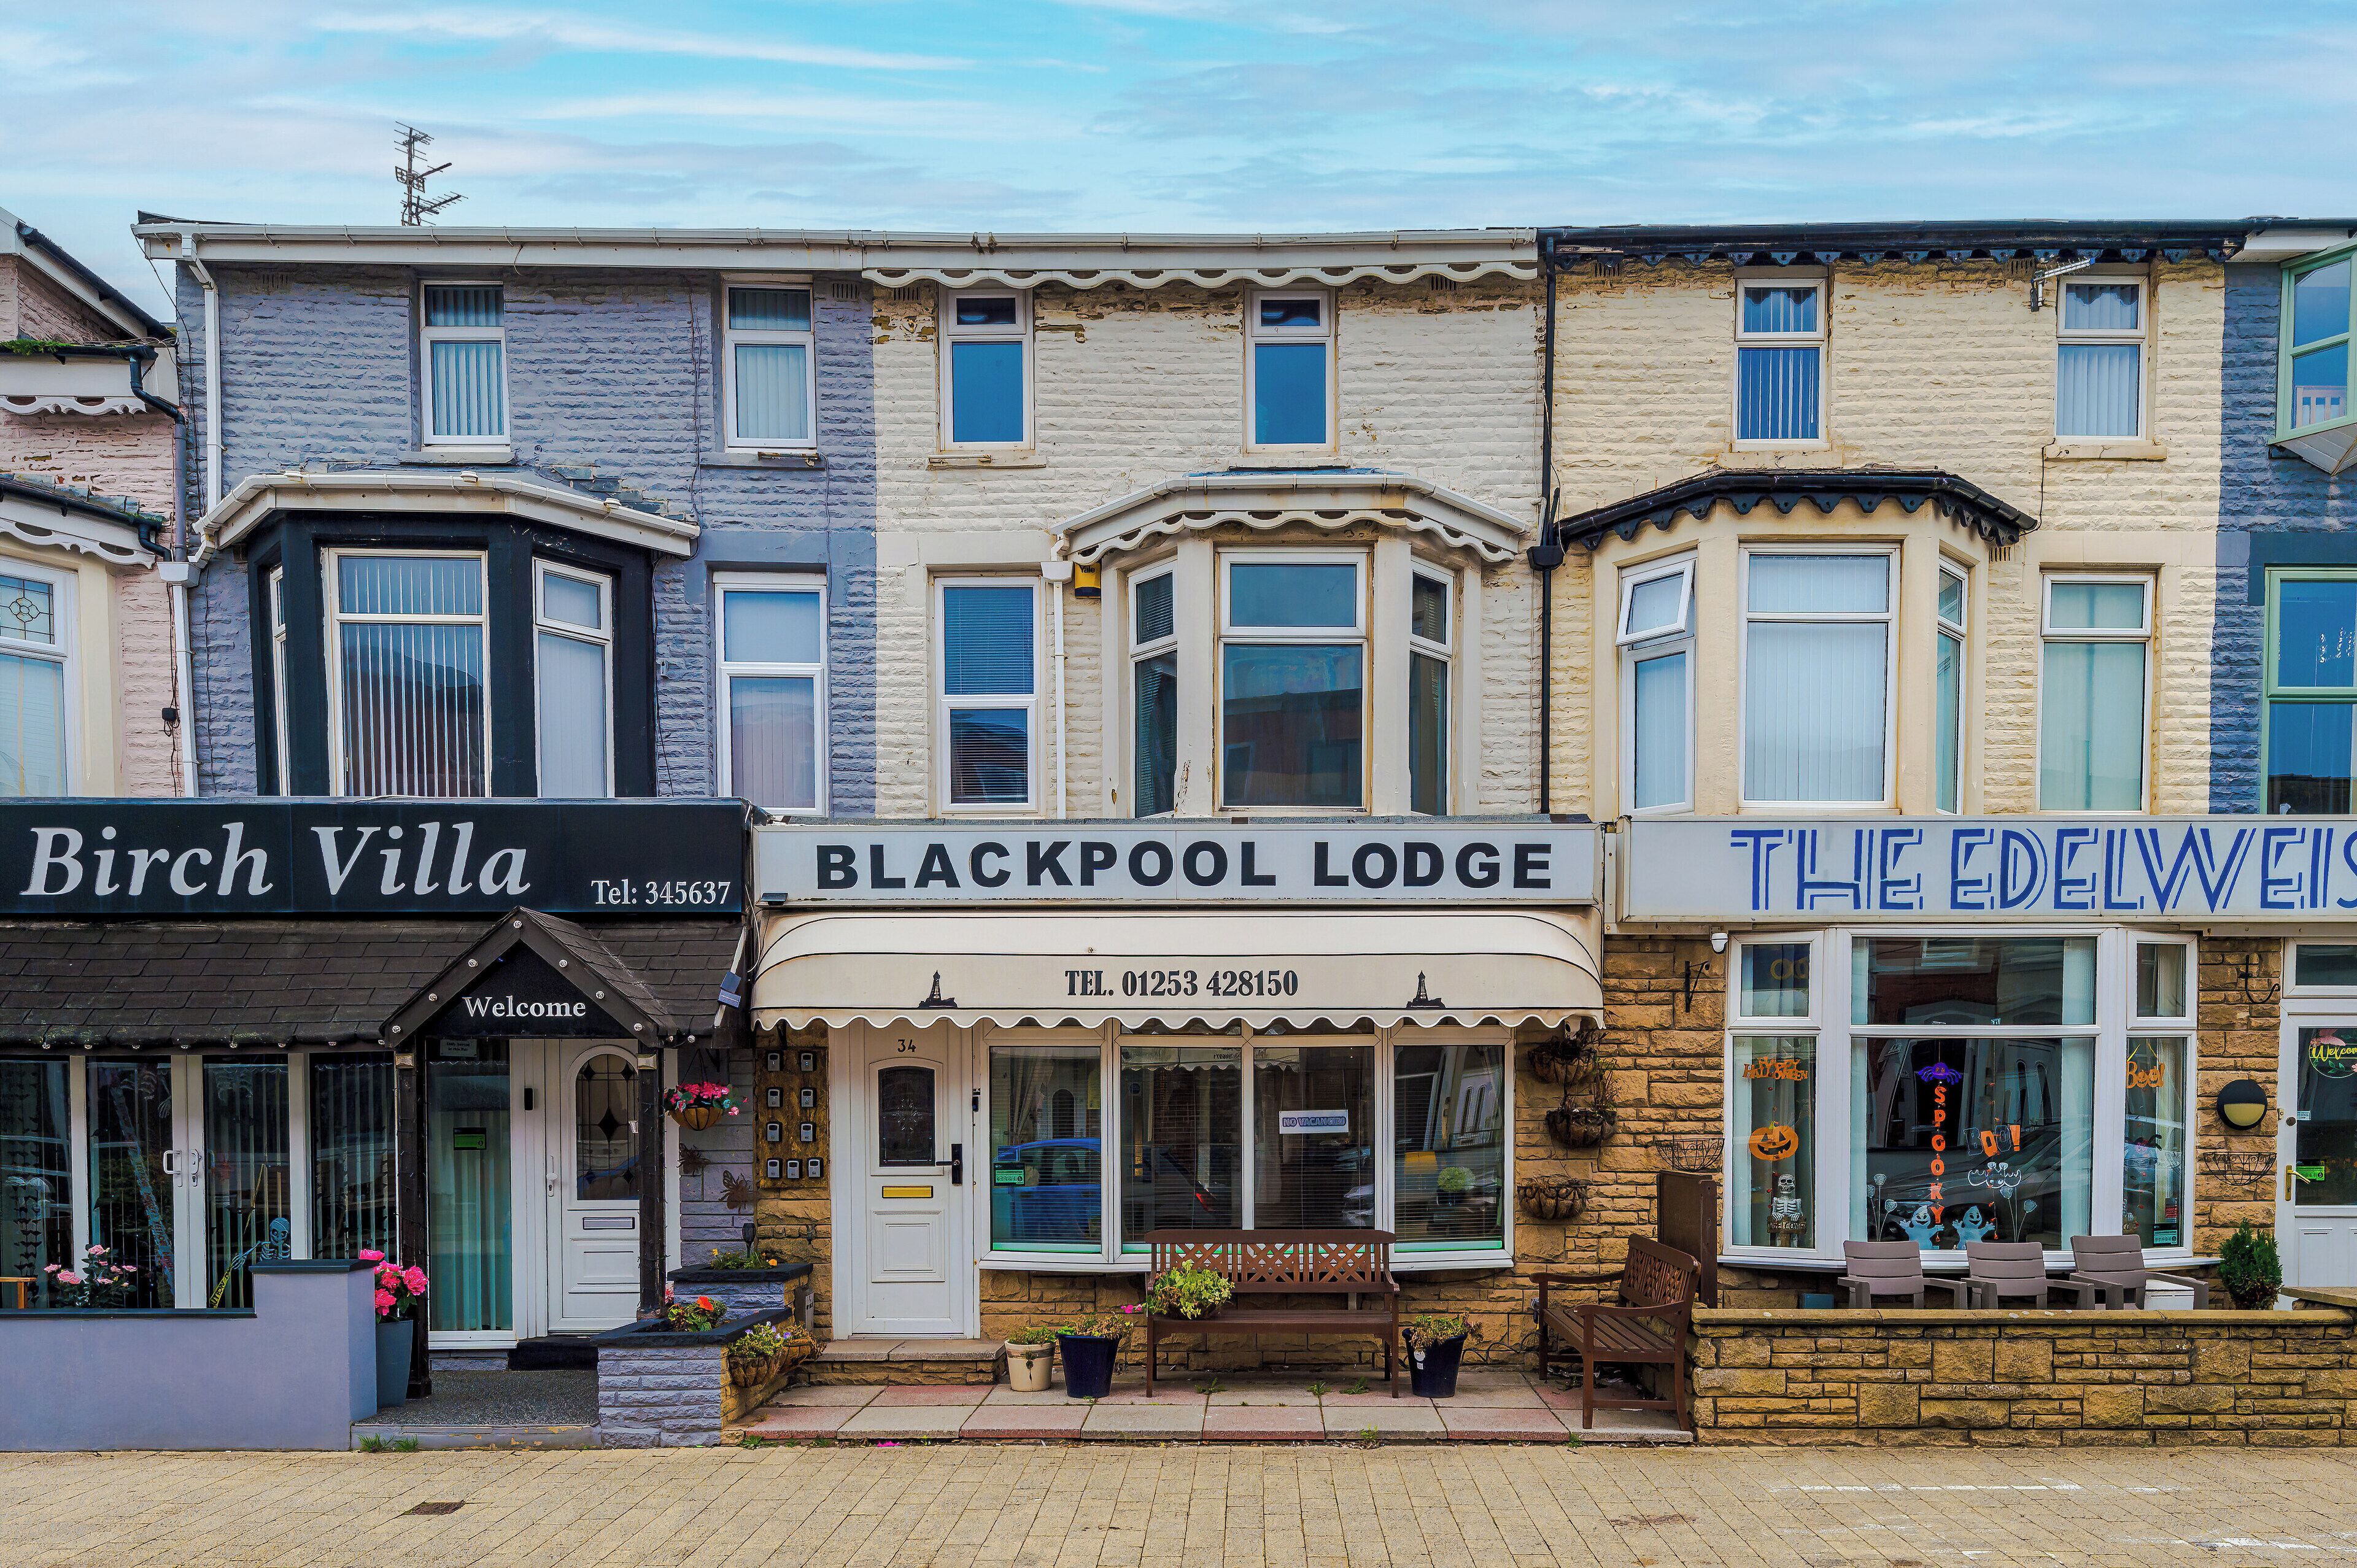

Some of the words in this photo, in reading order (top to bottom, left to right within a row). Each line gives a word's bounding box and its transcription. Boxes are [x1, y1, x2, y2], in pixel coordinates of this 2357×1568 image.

[1080, 565, 1096, 573] Yale
[20, 822, 274, 896] Birch
[311, 821, 531, 895] Villa
[816, 840, 1276, 890] BLACKPOOL
[1314, 841, 1552, 889] LODGE
[1730, 827, 1924, 911] THE
[591, 879, 637, 905] Tel:
[646, 881, 731, 905] 345637
[1064, 970, 1114, 997] TEL.
[1121, 970, 1198, 997] 01253
[1206, 970, 1298, 997] 428150
[462, 995, 586, 1018] Welcome
[897, 1039, 916, 1052] 34
[1743, 1064, 1808, 1081] HALLOWEEN
[1282, 1118, 1298, 1127] NO
[1963, 1124, 2021, 1158] BOO!
[1930, 1086, 1946, 1224] SPOOKY
